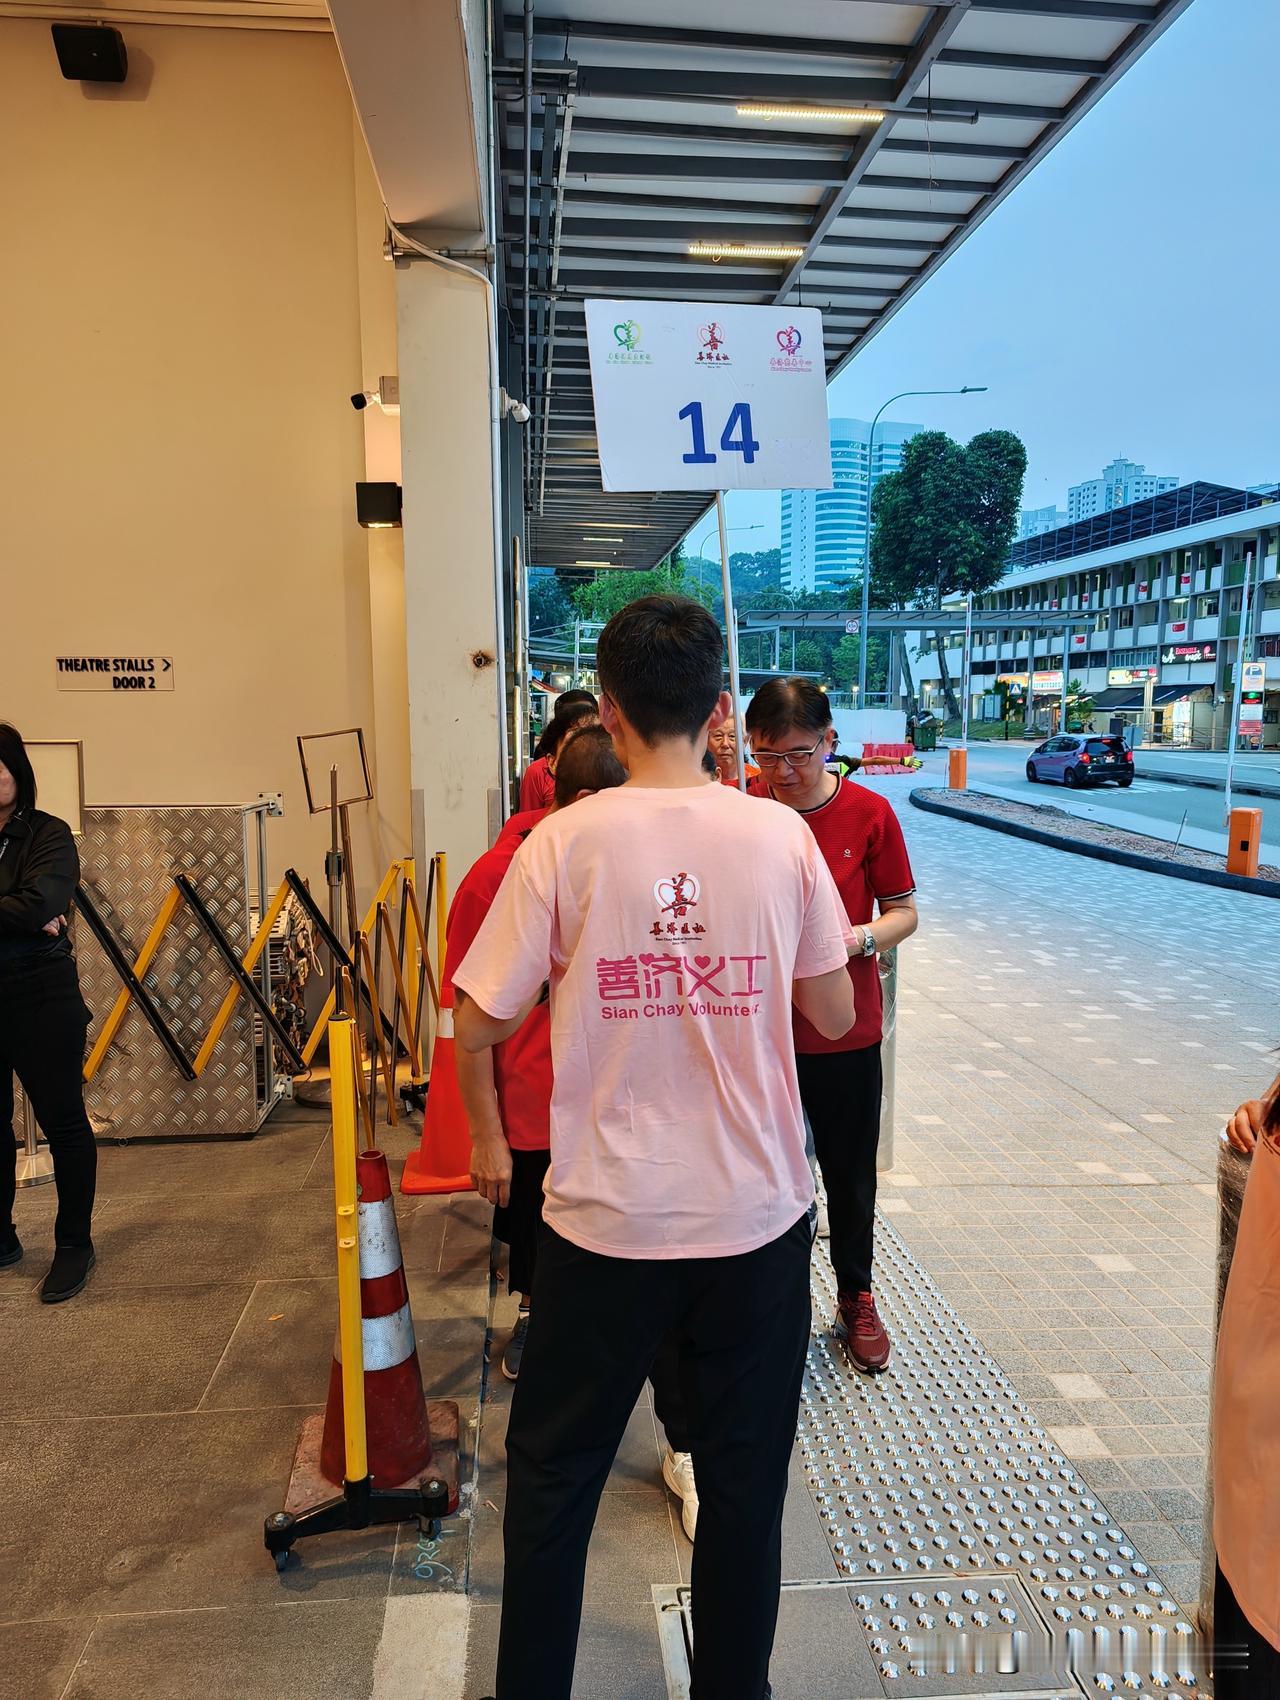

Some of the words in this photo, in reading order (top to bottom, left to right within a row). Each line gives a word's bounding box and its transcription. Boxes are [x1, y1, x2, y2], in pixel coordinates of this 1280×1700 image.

[678, 401, 760, 464] 14
[57, 659, 110, 672] THEATRE
[112, 659, 154, 672] STALLS
[113, 677, 146, 689] DOOR
[148, 677, 155, 689] 2
[597, 952, 767, 1001] 善济义工
[602, 1007, 639, 1020] Sian
[643, 1004, 685, 1018] Chay
